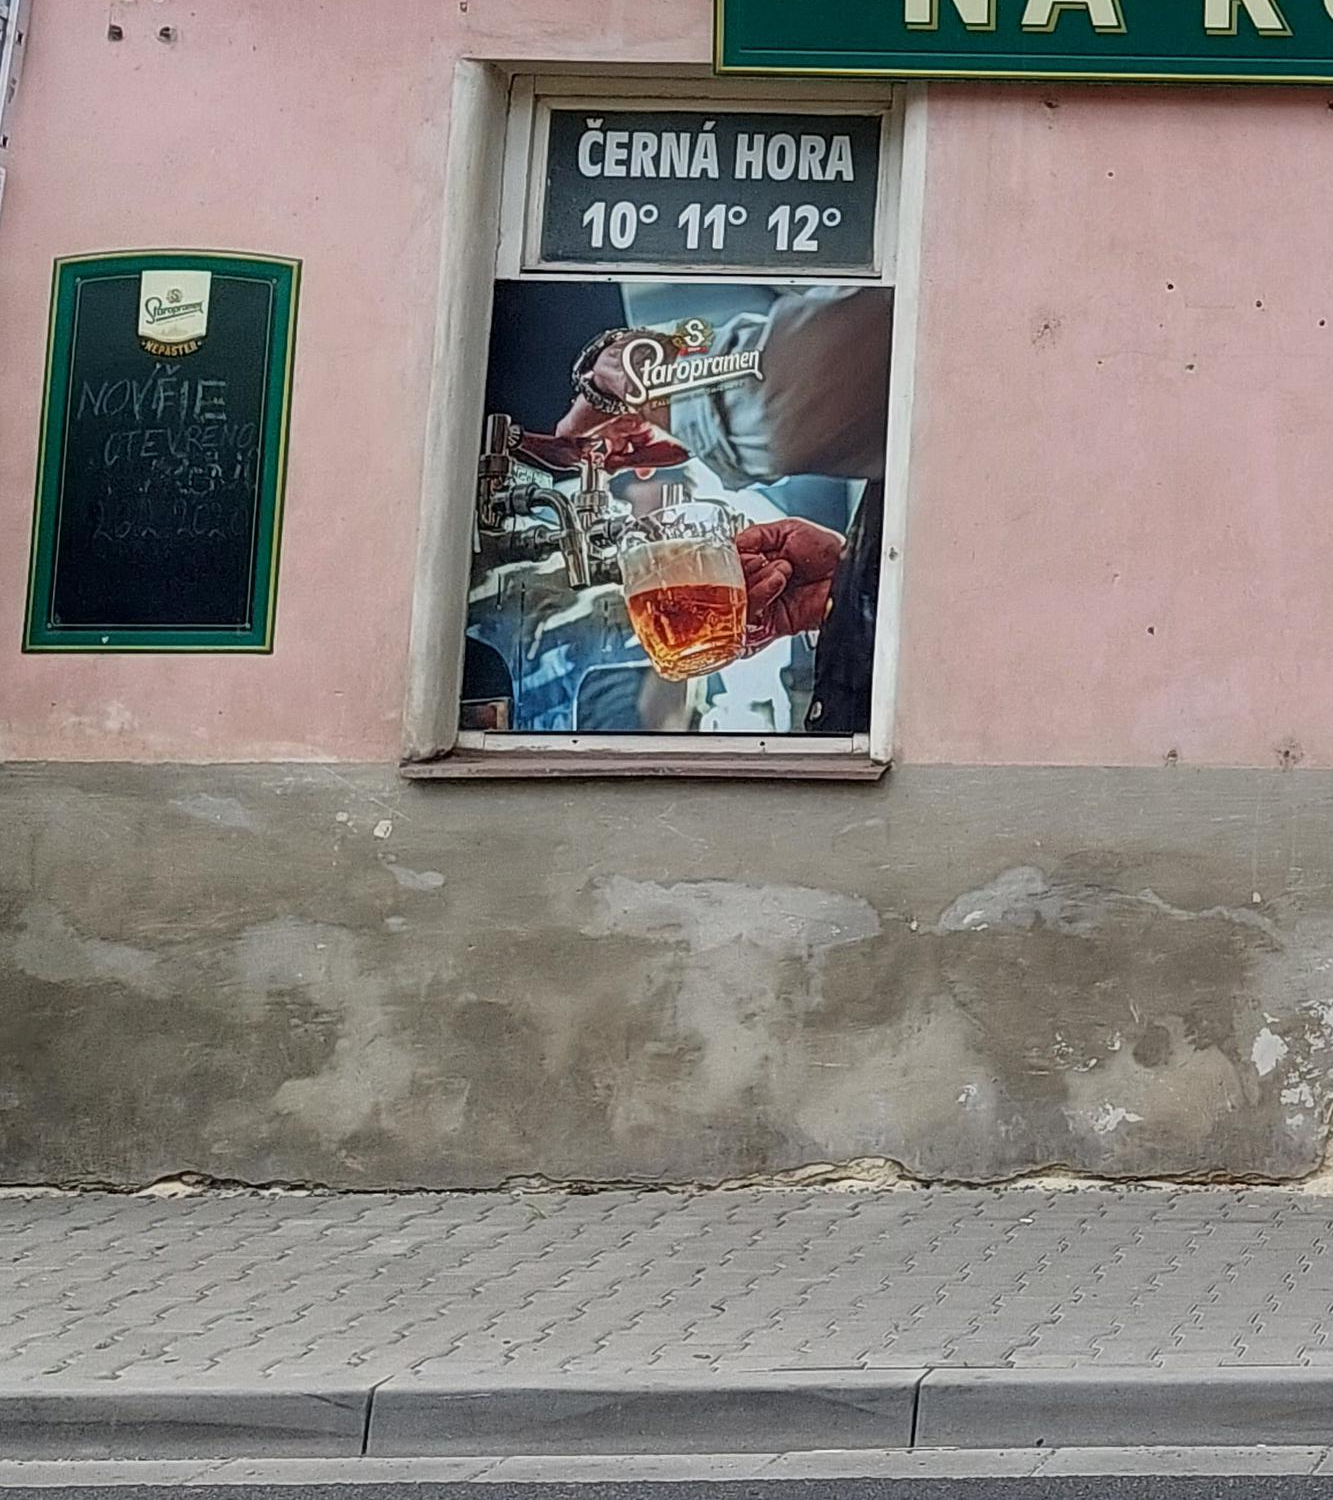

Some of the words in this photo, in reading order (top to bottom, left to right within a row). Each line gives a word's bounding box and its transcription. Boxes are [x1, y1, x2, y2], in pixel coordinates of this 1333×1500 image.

[578, 118, 720, 179] ČERNÁ
[734, 133, 854, 181] HORA
[582, 201, 659, 249] 10°
[678, 203, 748, 250] 11°
[767, 204, 842, 251] 12°
[622, 338, 764, 405] Staropramen
